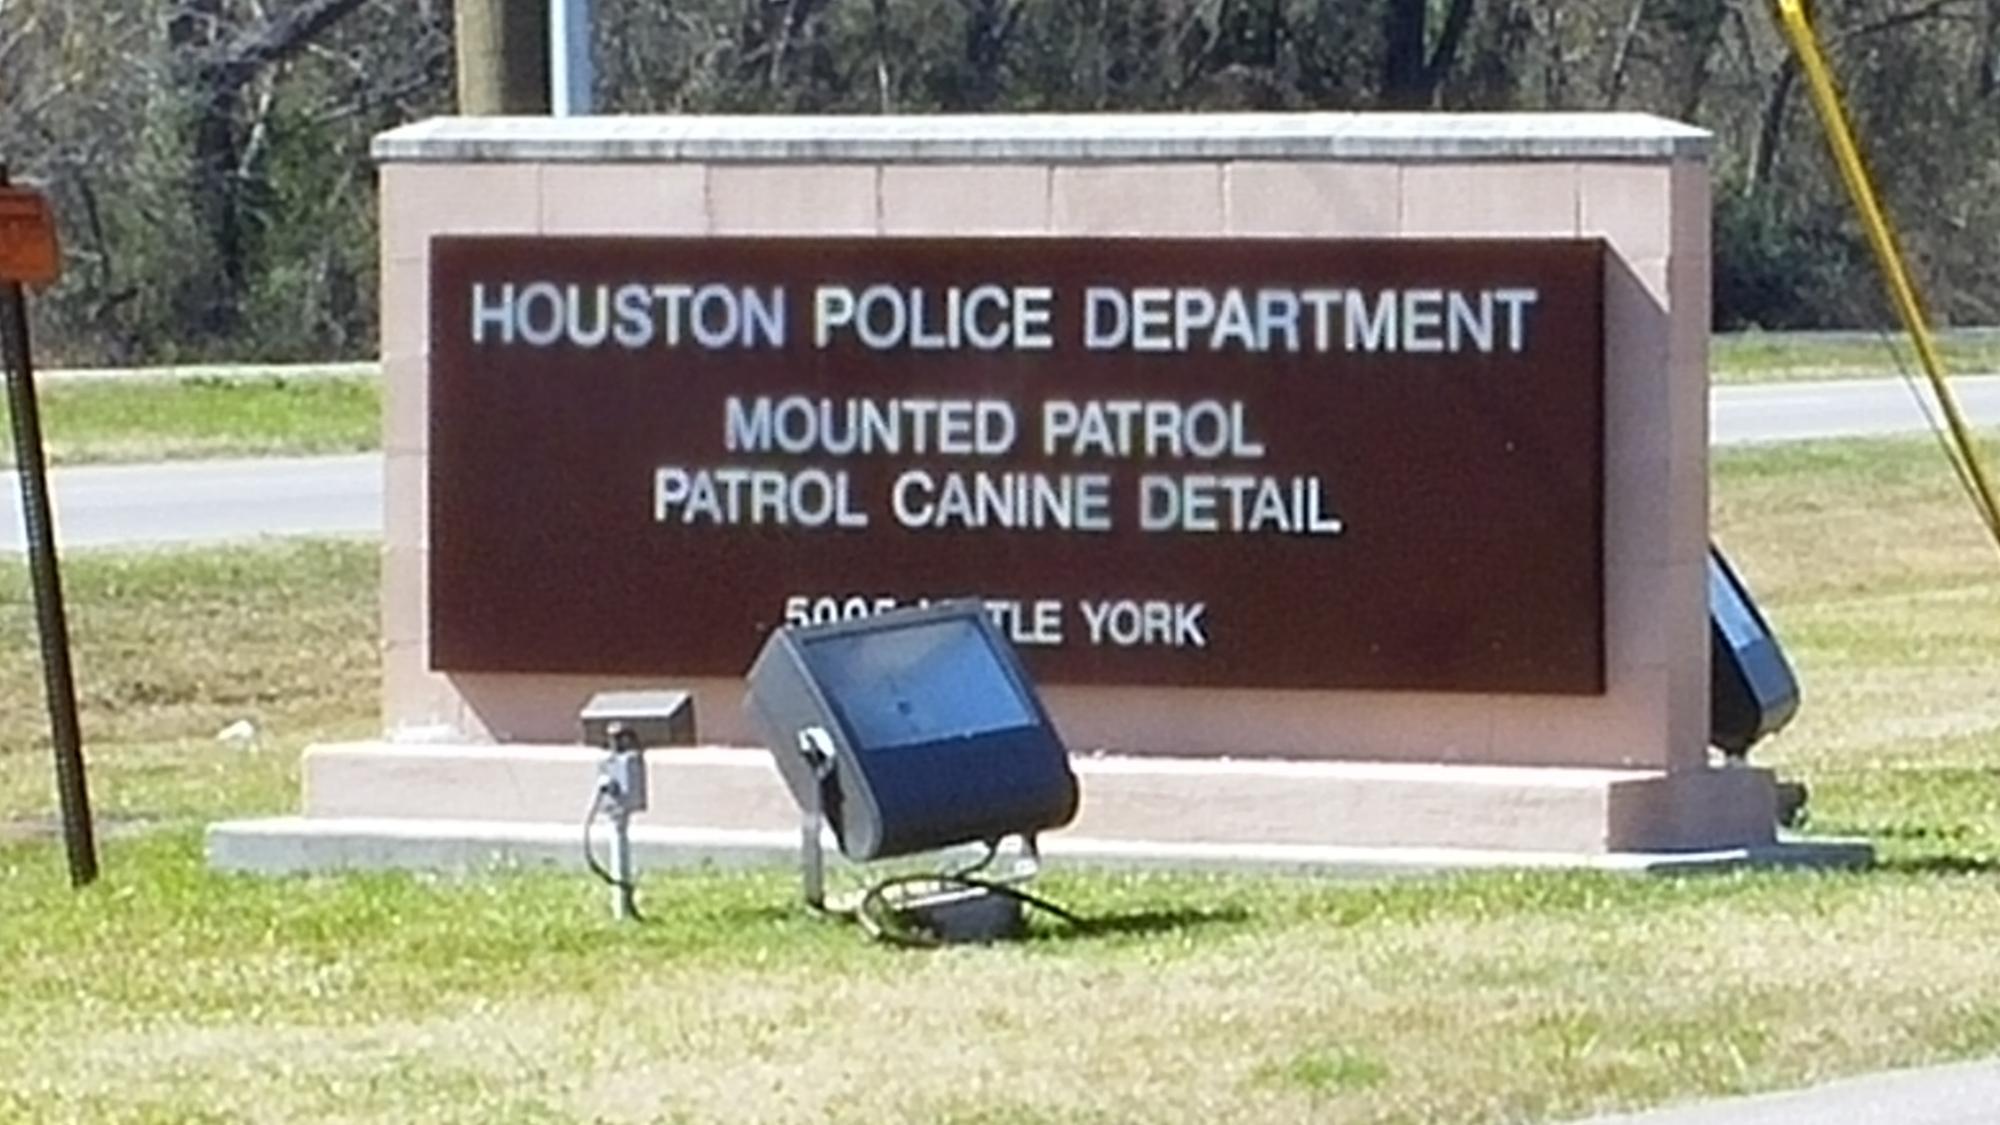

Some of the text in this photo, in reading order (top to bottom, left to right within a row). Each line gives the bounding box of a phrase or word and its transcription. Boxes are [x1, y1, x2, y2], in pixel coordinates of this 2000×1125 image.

[472, 283, 1538, 352] HOUSTON POLICE DEPARTMENT
[725, 396, 1265, 457] MOUNTED PATROL
[654, 467, 1343, 533] PATROL CANINE DETAIL
[1081, 600, 1206, 646] YORK
